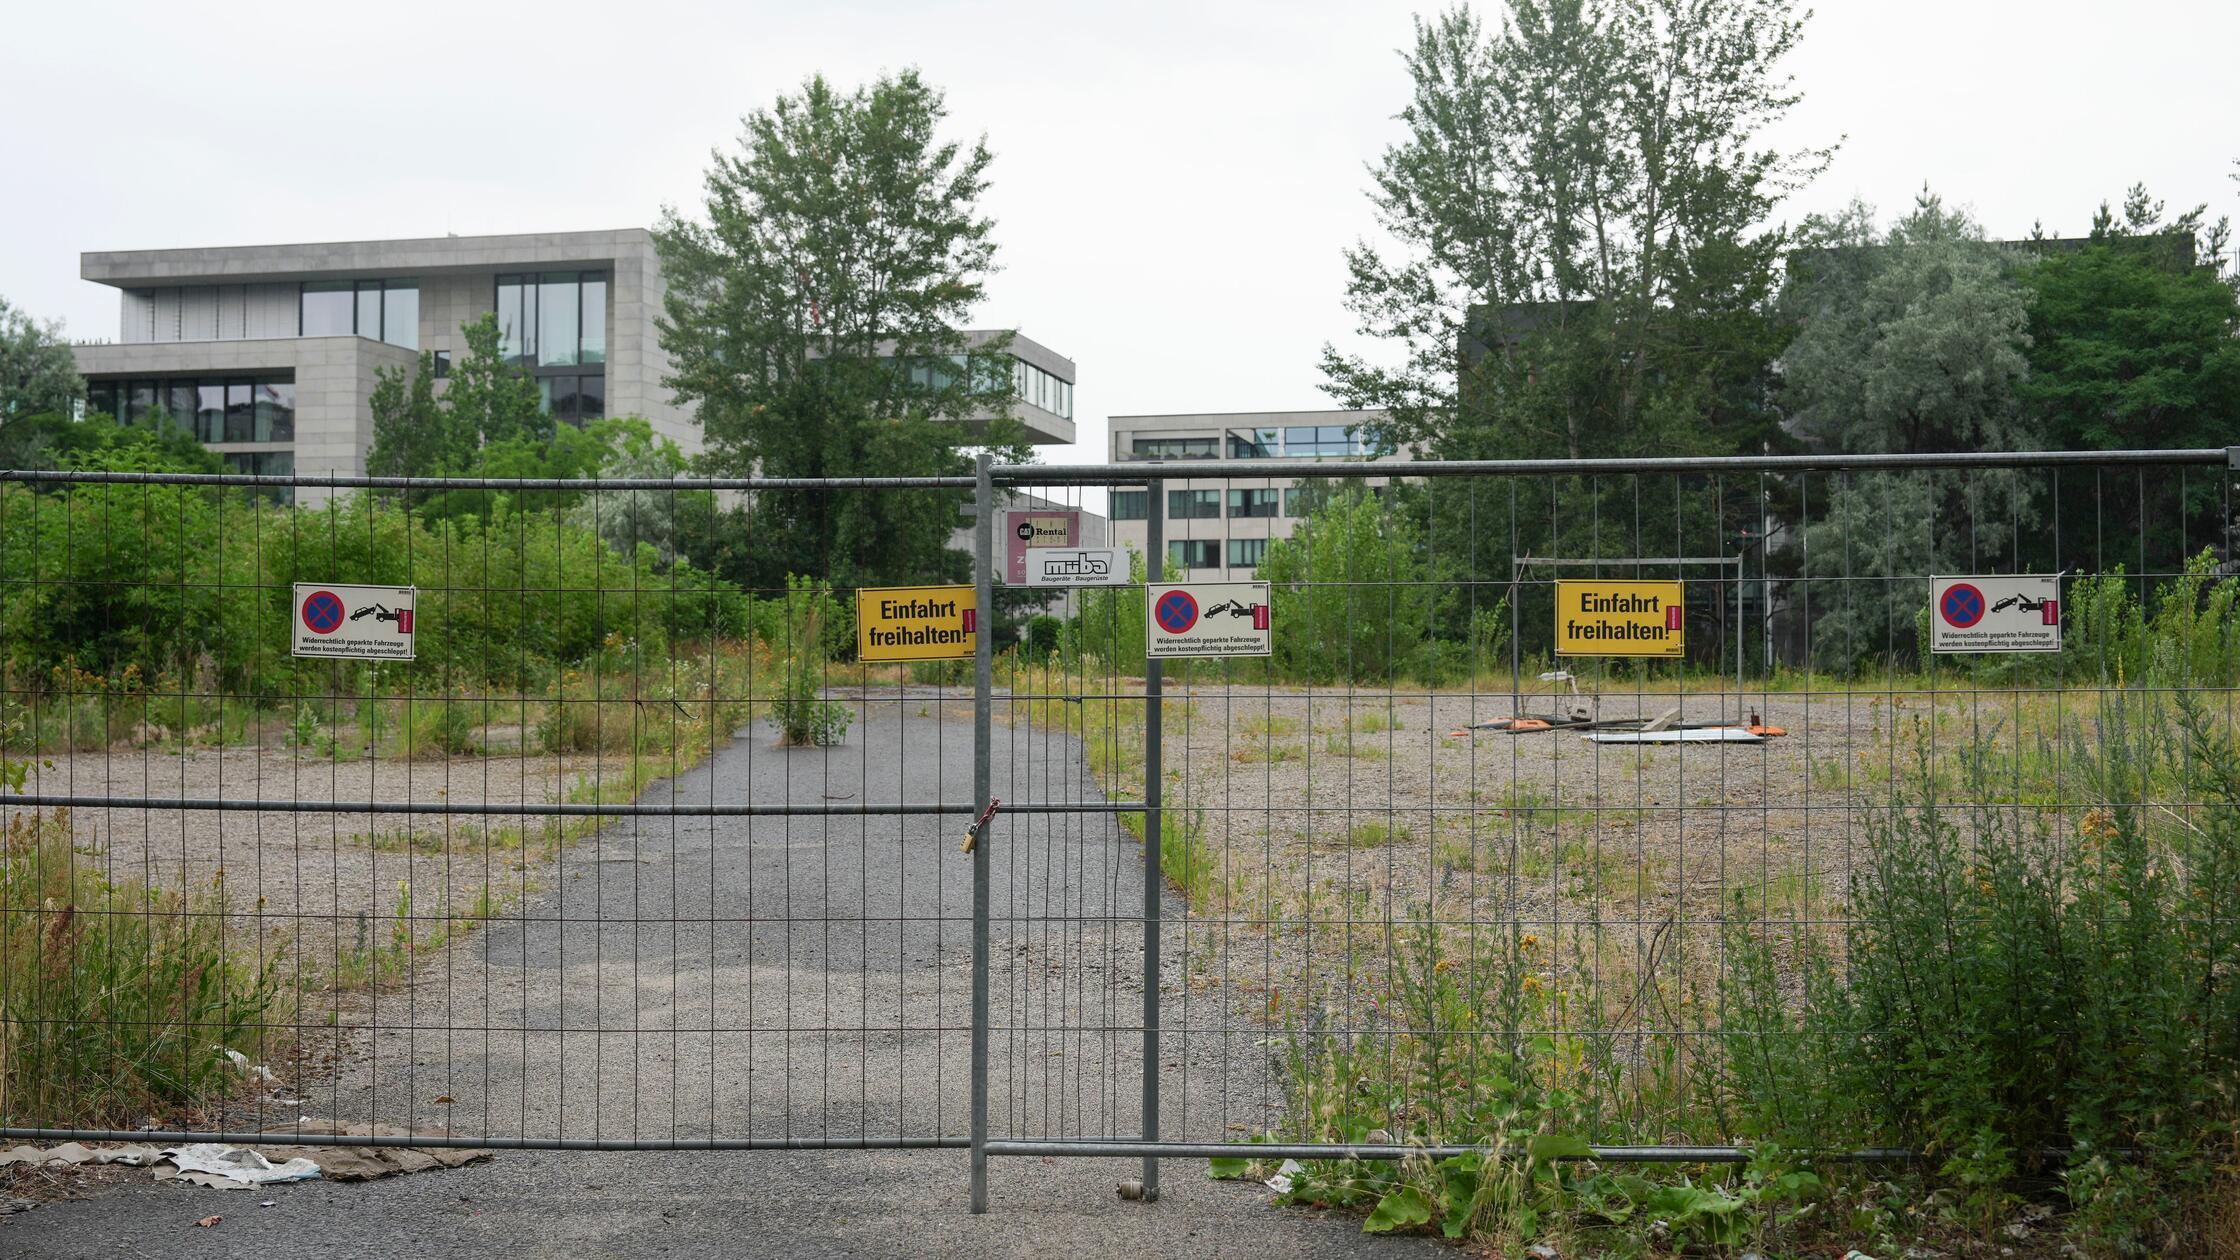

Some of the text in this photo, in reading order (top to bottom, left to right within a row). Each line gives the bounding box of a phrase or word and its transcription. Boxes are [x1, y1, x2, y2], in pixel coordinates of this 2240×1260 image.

[1036, 527, 1067, 536] Rental
[1045, 552, 1108, 575] müba
[1041, 575, 1109, 583] Baugeräte Baugerüste
[1581, 593, 1659, 613] Einfahrt
[881, 599, 956, 620] Einfahrt
[869, 624, 967, 646] freihalten!
[1567, 620, 1669, 640] freihalten!
[1157, 636, 1261, 645] Widerrechtlich geparkte Fahrzeuge
[1941, 631, 2050, 641] Widerrechtlich geparkte Fahrzeuge
[302, 636, 404, 648] Widerrechtlich geparkte Fahrzeuge
[1964, 640, 2010, 649] kostenpflichtig
[2011, 639, 2054, 648] abgeschleppt!
[299, 645, 408, 656] werden kostenpflichtig abgeschleppt!
[1154, 643, 1265, 653] werden kostenpflichtig abgeschleppt!
